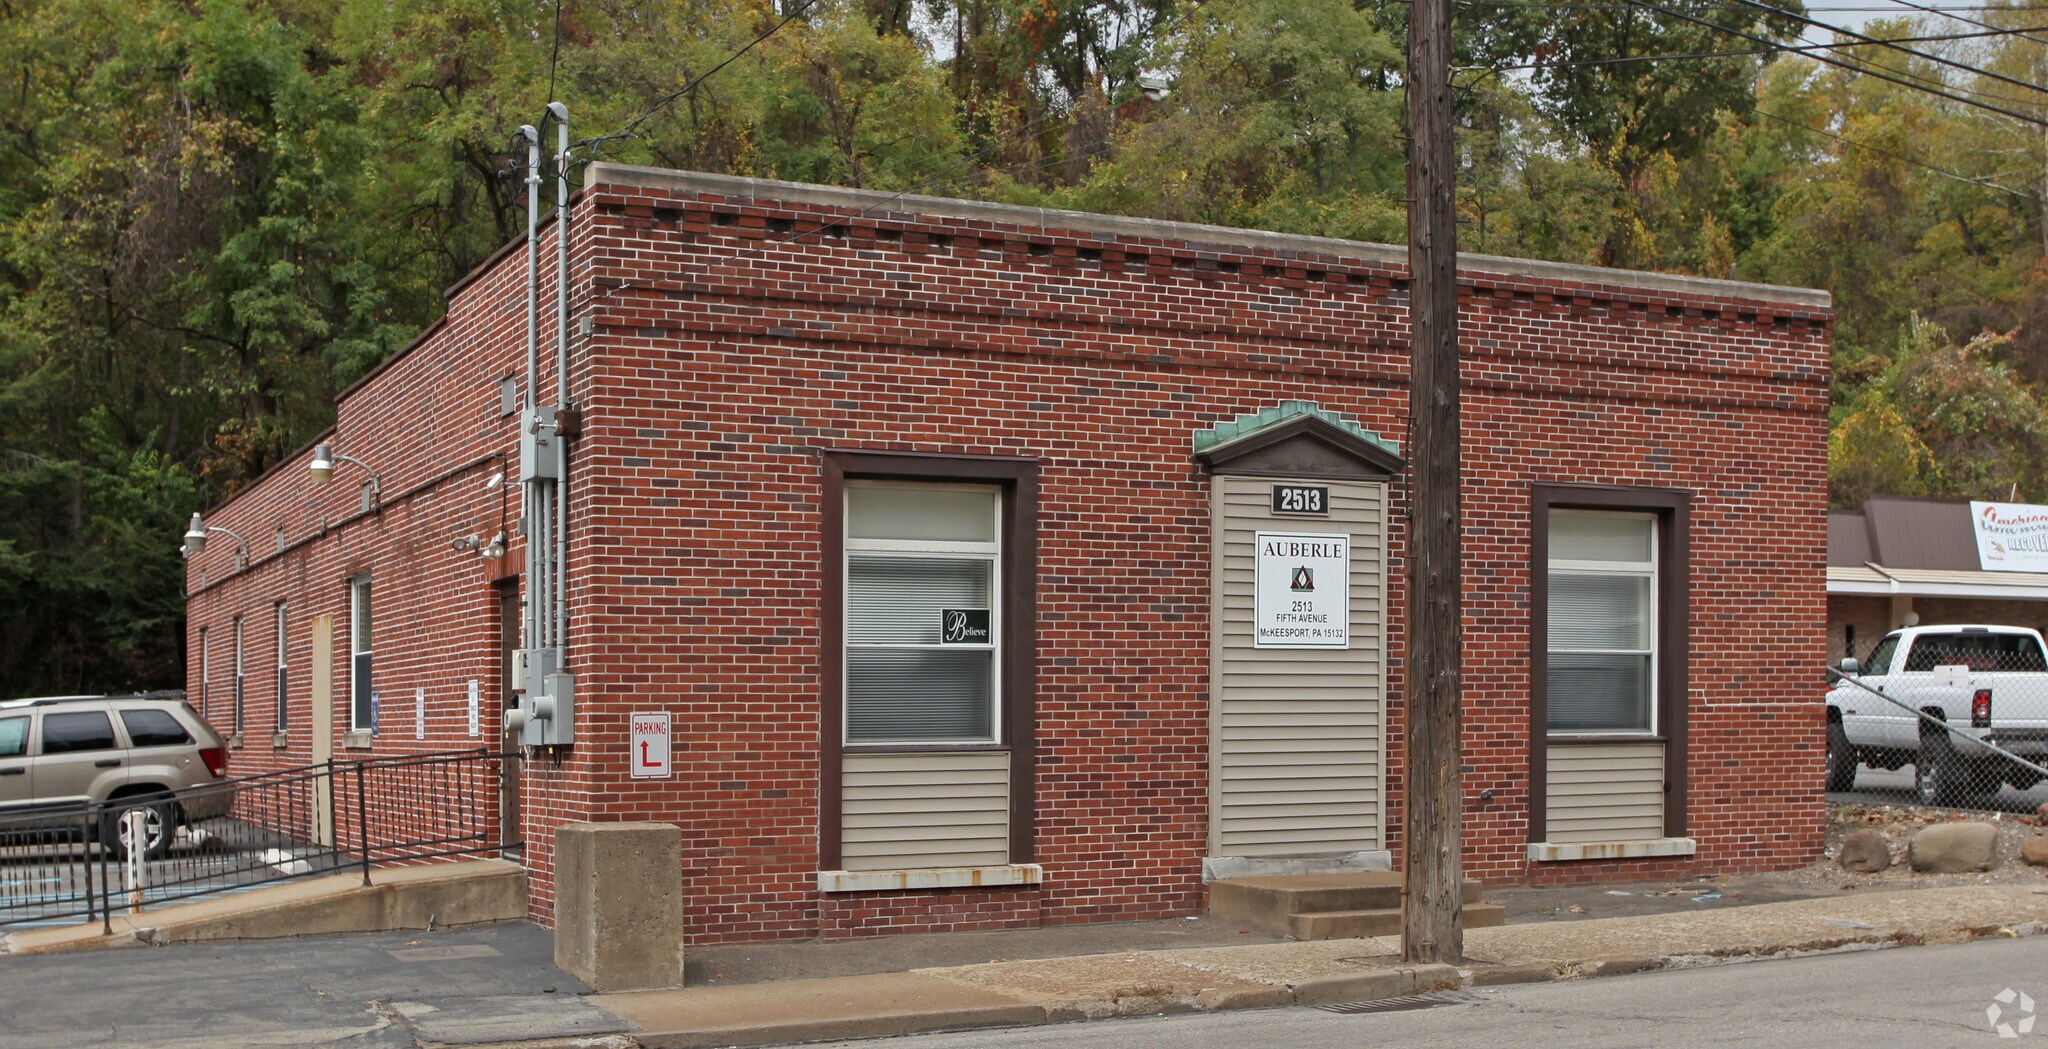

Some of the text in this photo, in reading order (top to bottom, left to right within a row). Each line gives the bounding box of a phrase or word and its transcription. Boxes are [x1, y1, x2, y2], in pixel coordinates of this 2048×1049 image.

[1281, 488, 1321, 511] 2513
[1263, 541, 1342, 559] AUBERLE
[2007, 534, 2048, 553] RECOVE
[1292, 600, 1313, 612] 2513
[946, 610, 986, 641] Believe
[1276, 613, 1328, 624] FIFTH AVENUE
[1260, 628, 1344, 639] McKEESPORT, PA 15132
[634, 721, 667, 735] PARKING
